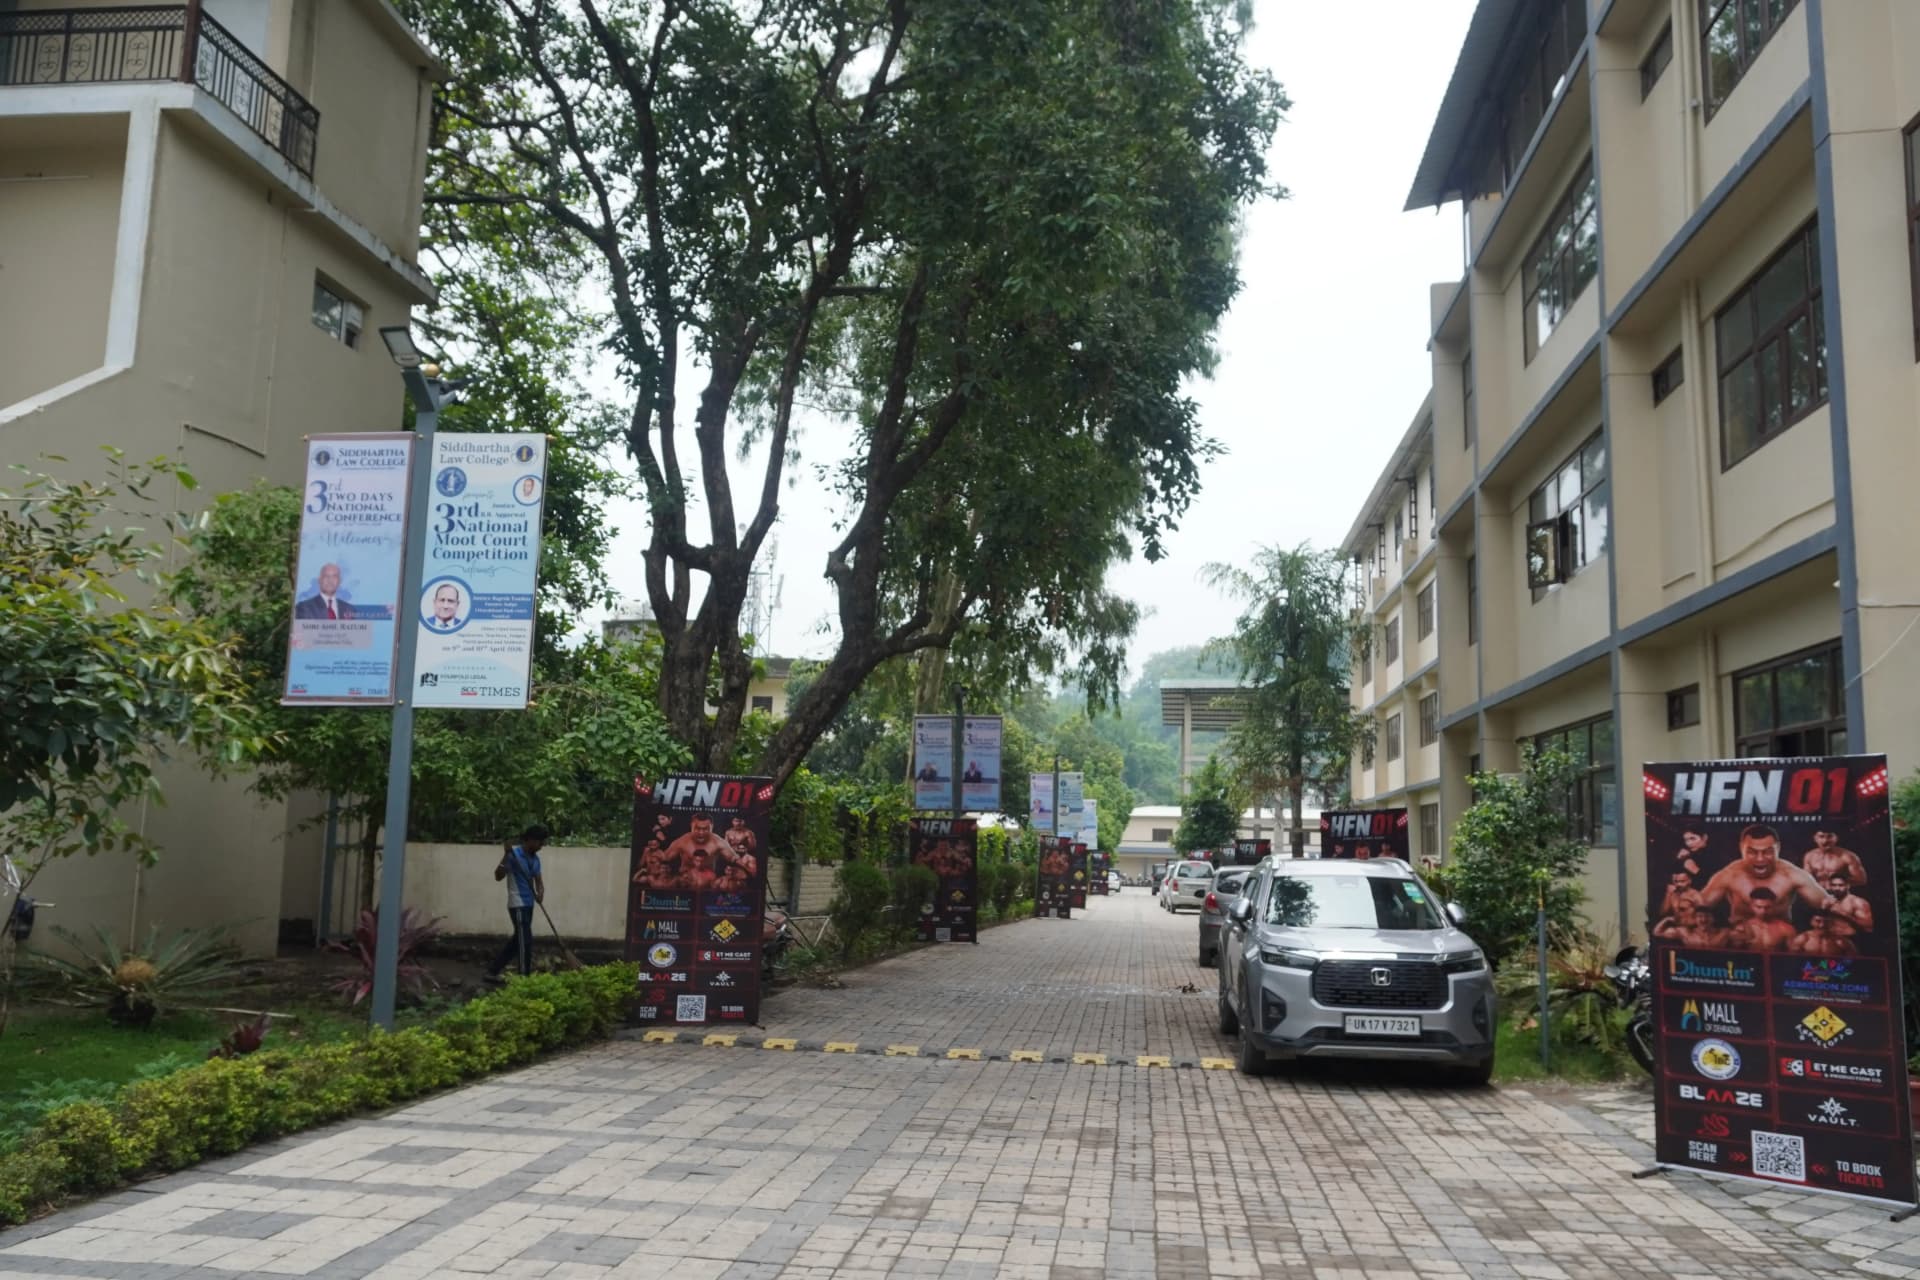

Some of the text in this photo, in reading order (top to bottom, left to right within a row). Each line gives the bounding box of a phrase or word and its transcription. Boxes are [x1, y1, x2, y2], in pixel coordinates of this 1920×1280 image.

[339, 448, 405, 457] SIDDHARTHA
[440, 441, 511, 453] Siddhartha
[336, 457, 406, 466] LAW COLLEGE
[439, 454, 510, 466] Law College
[328, 492, 393, 502] TWO DAYS
[327, 503, 386, 512] NATIONAL
[326, 513, 402, 522] CONFERENCE
[455, 520, 528, 533] National
[435, 533, 527, 547] Moot Court
[432, 547, 528, 562] Competition
[480, 687, 521, 697] TIMES
[652, 778, 755, 808] HFN 01
[1671, 768, 1849, 815] HFN 01
[920, 821, 952, 834] HFN
[1331, 813, 1394, 837] HFN 01
[658, 920, 679, 934] MALL
[1703, 1001, 1739, 1024] MALL
[1830, 1064, 1848, 1074] ME
[1849, 1066, 1882, 1077] CAST
[1808, 1113, 1857, 1126] VAULT
[1688, 1140, 1718, 1153] SCAN
[1688, 1150, 1718, 1163] HERE
[1836, 1160, 1882, 1176] TO BOOK
[1838, 1171, 1885, 1189] TICKETS
